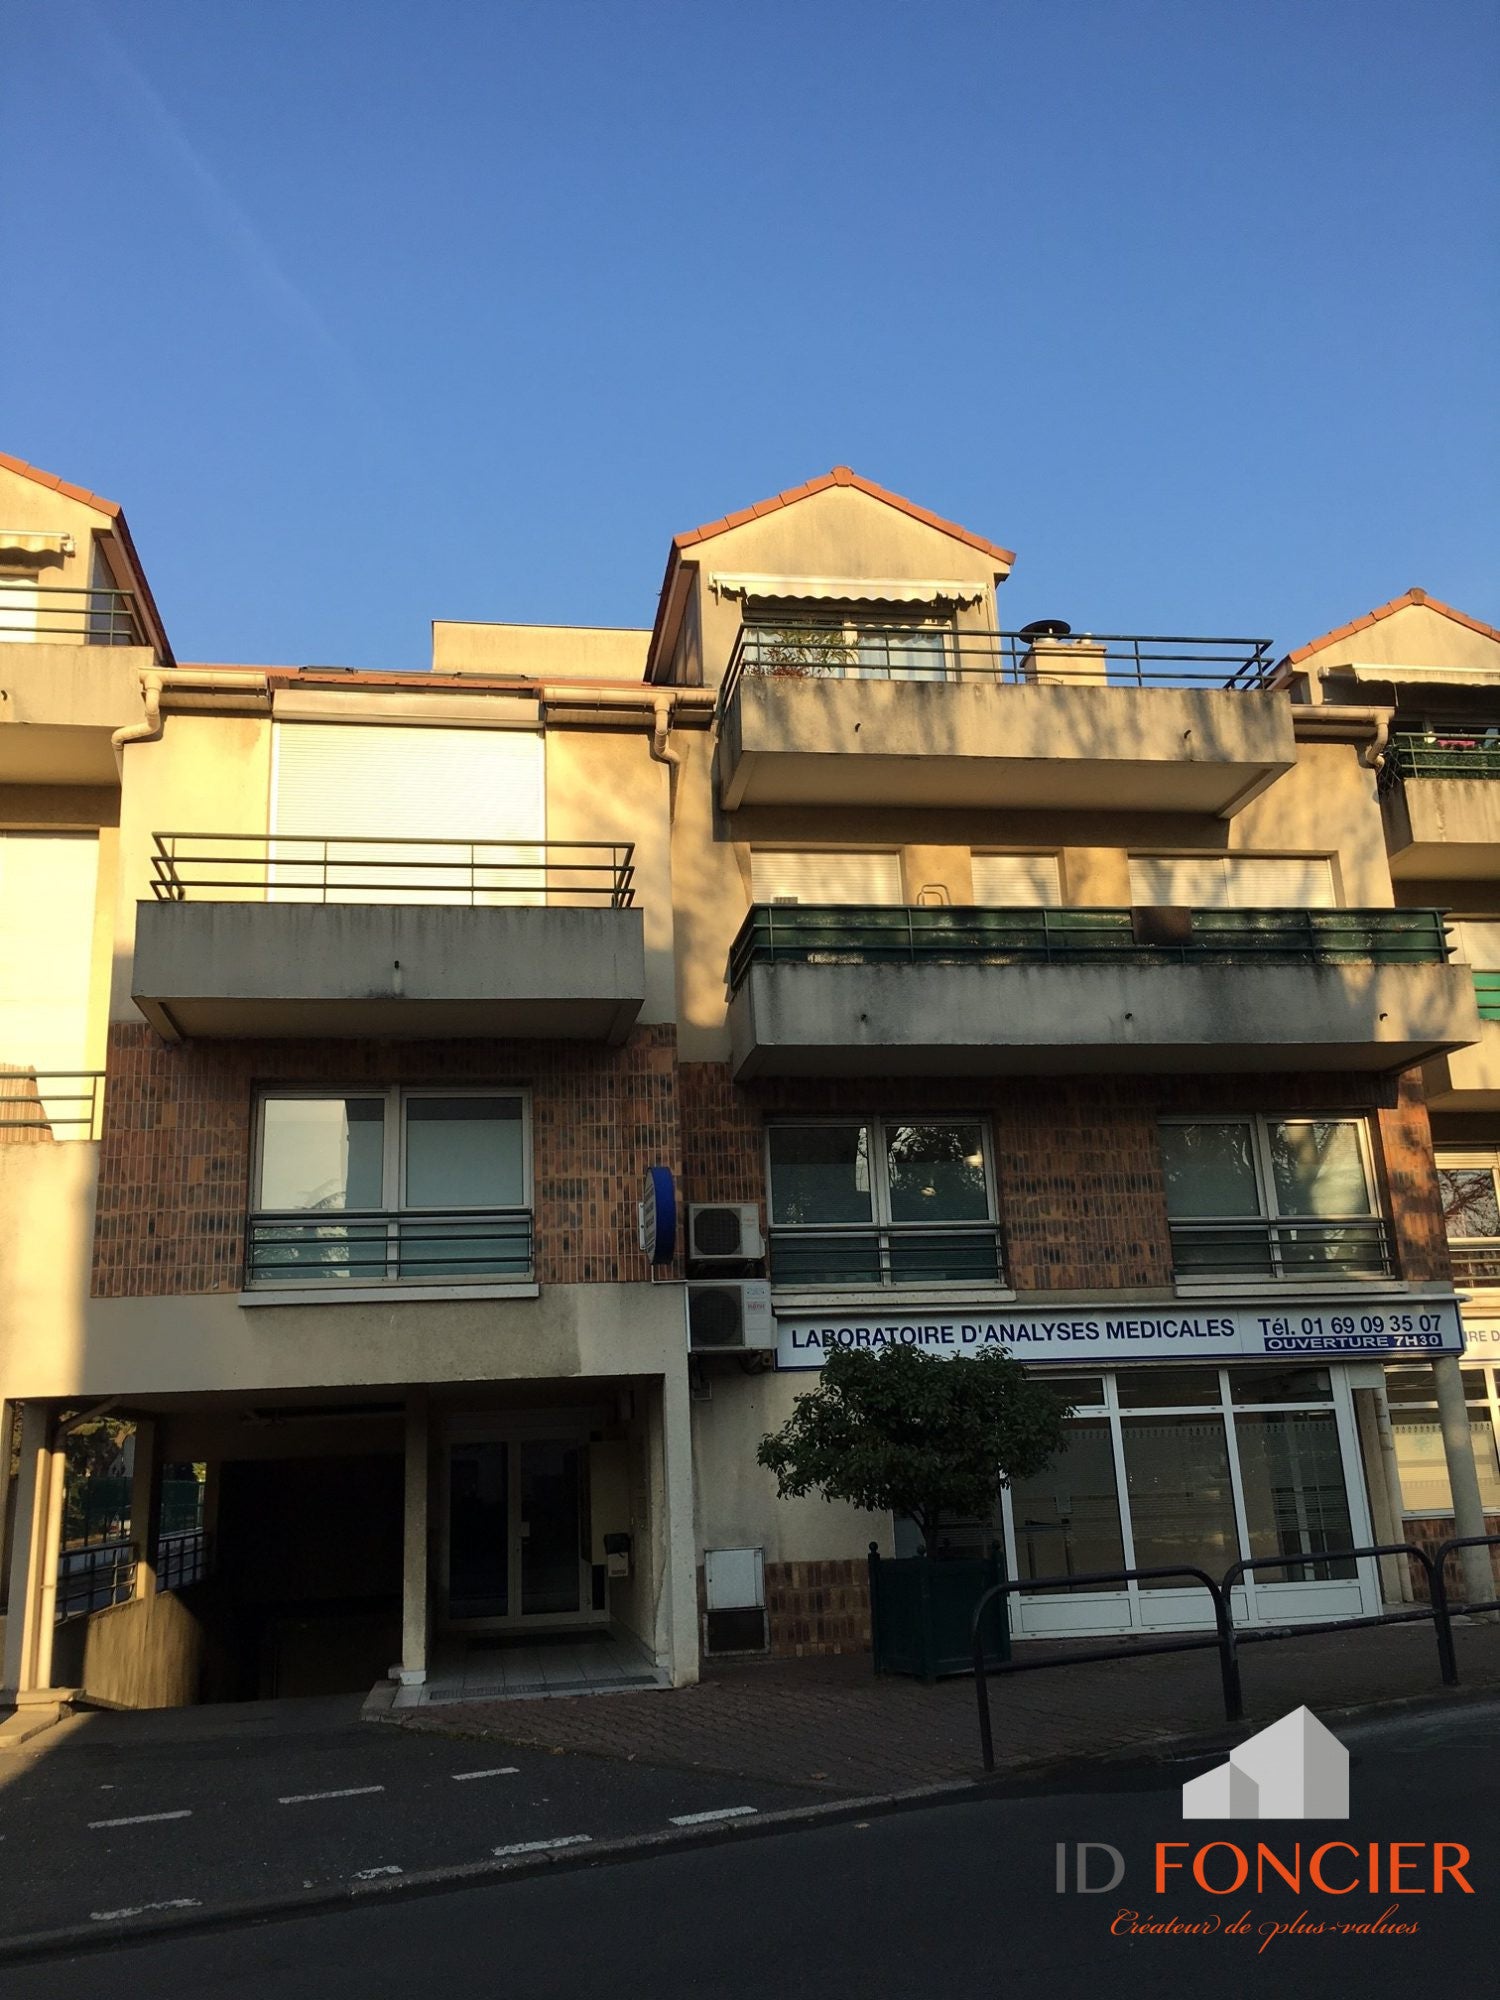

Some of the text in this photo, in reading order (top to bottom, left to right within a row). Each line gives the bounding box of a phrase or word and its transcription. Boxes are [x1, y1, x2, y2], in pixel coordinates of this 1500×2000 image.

[791, 1318, 1235, 1348] LABORATOIRE D'ANALYSES MEDICALES
[1258, 1314, 1442, 1336] Tél. 01 69 09 35 07
[1268, 1335, 1440, 1350] OUVERTURE 7H30
